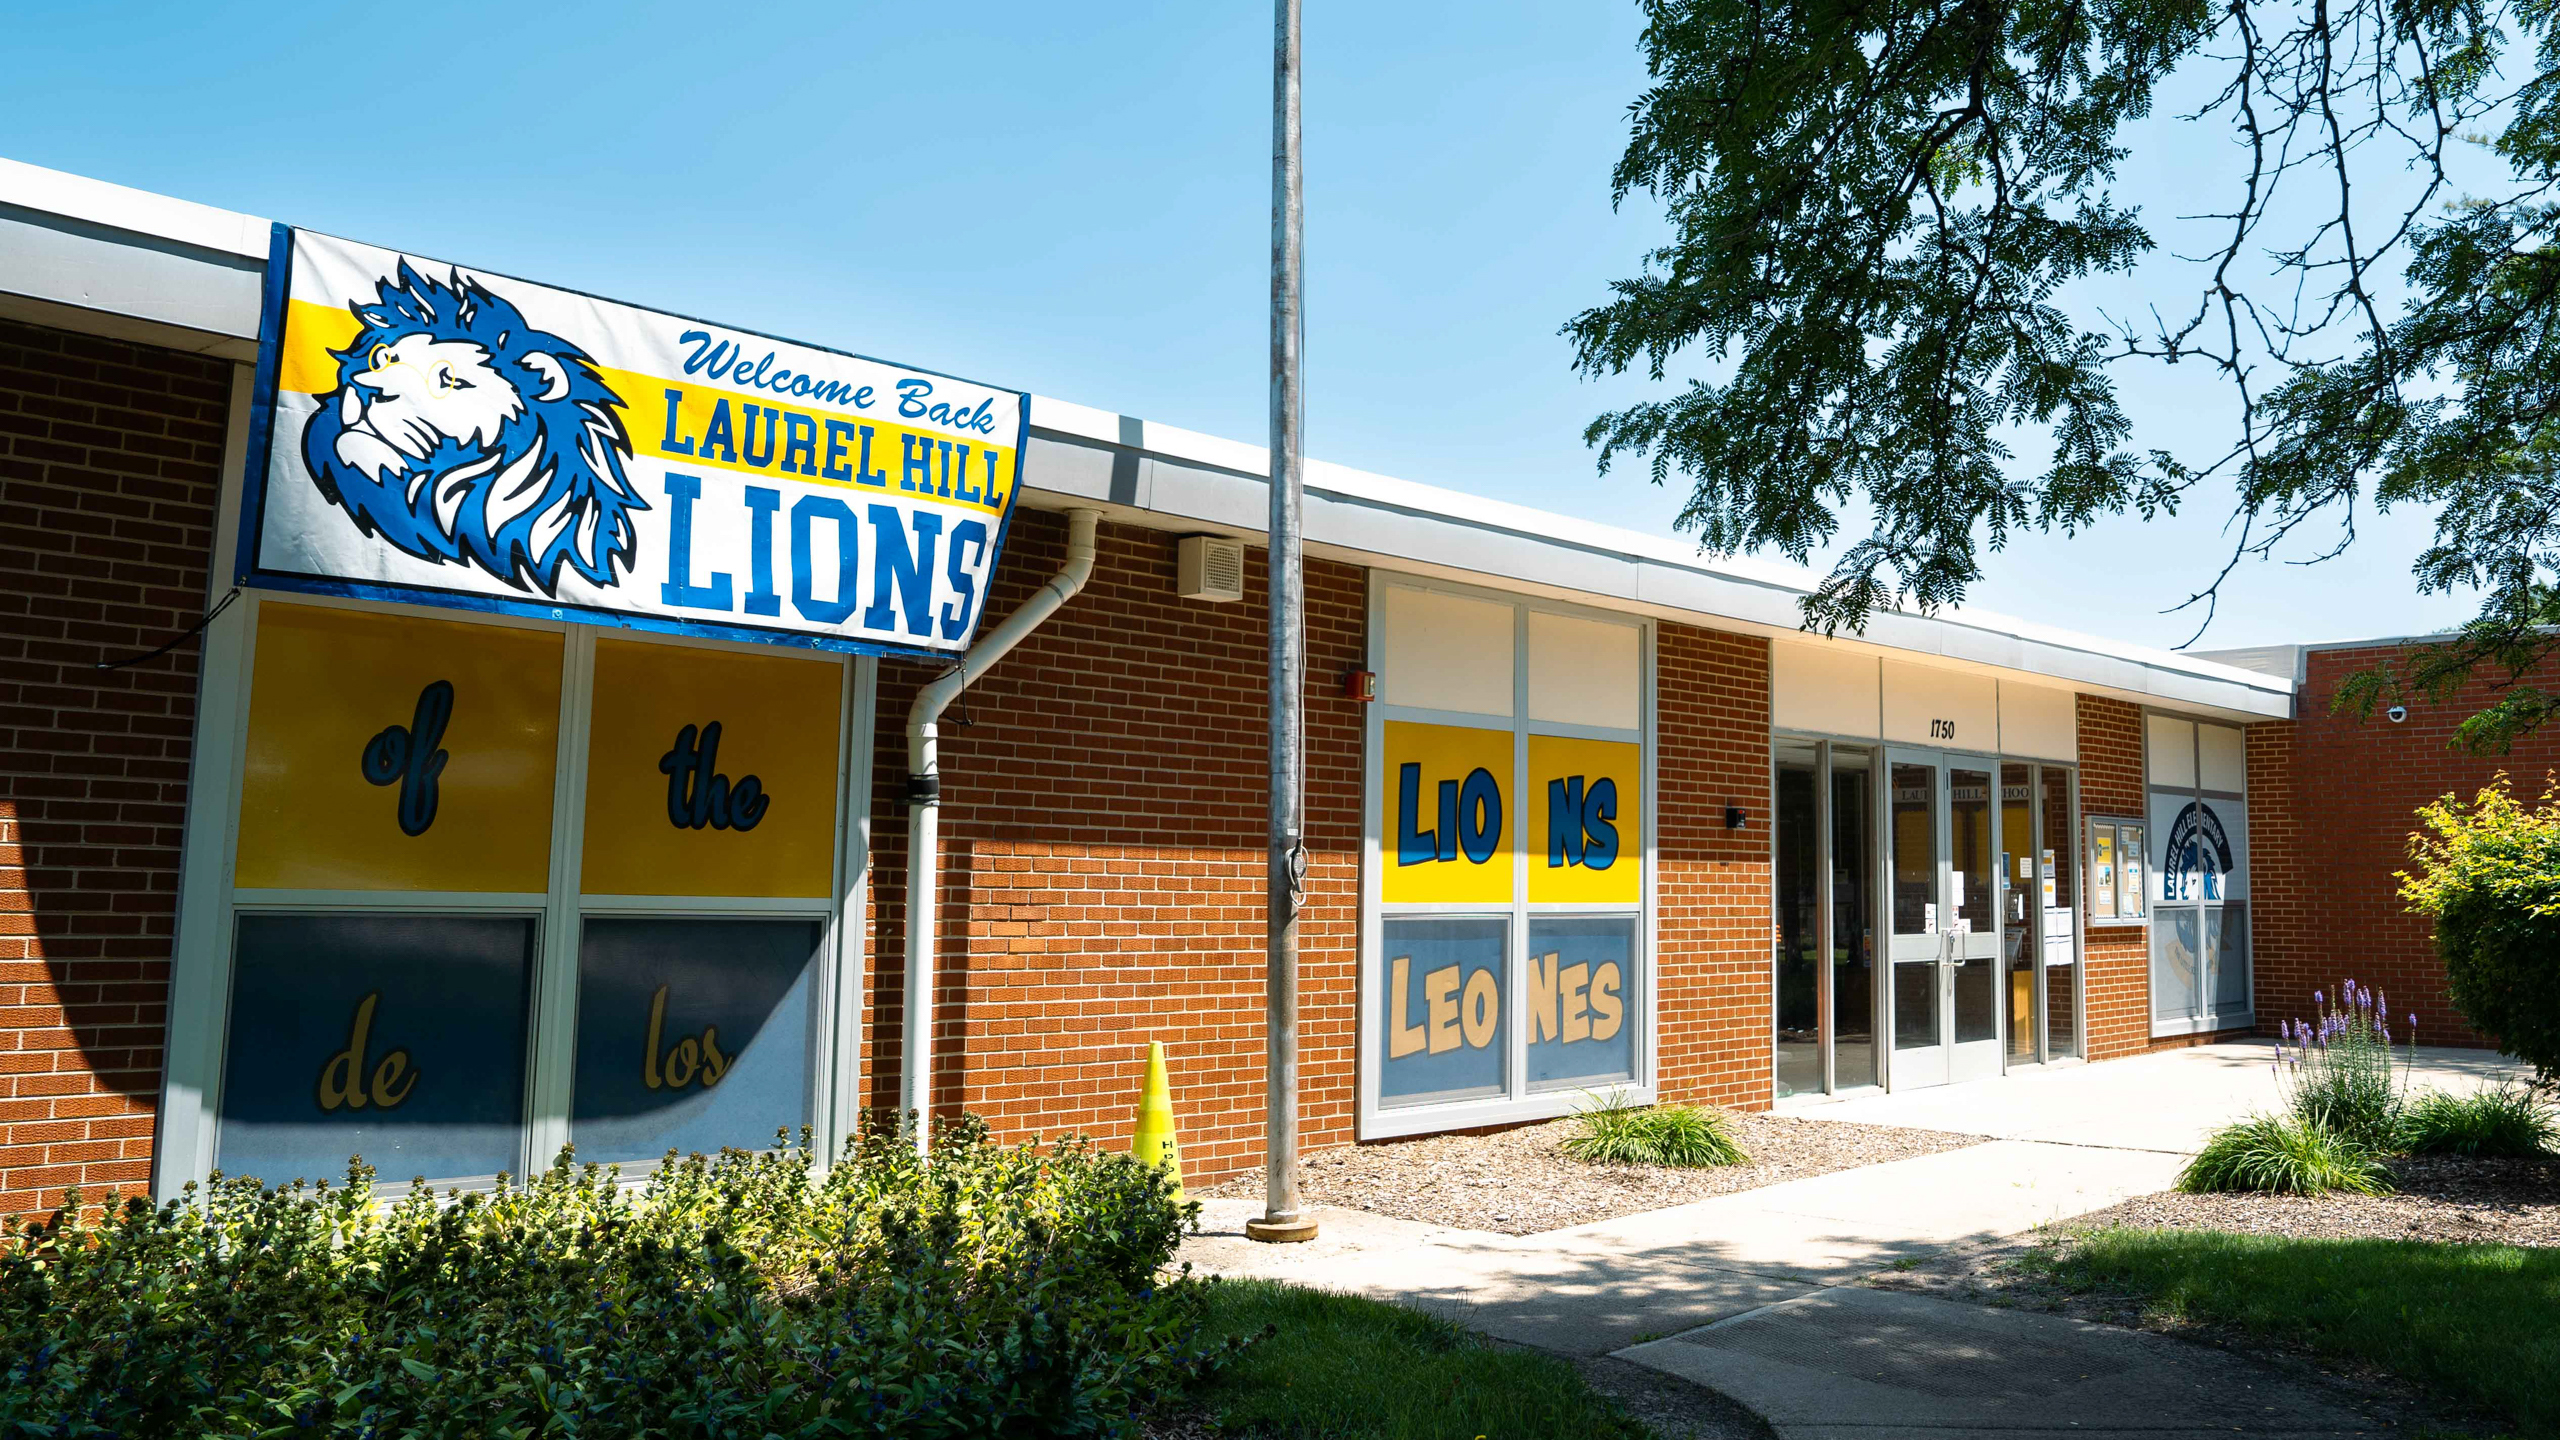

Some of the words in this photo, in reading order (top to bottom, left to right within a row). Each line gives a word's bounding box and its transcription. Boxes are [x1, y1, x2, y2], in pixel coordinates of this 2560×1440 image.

[679, 329, 876, 408] Welcome
[896, 378, 995, 434] Back
[661, 388, 886, 487] LAUREL
[900, 433, 1004, 509] HILL
[661, 471, 987, 641] LIONS
[361, 679, 455, 837] of
[658, 720, 771, 832] the
[1930, 718, 1955, 740] 1750
[2167, 844, 2180, 897] LAUREL
[2174, 819, 2188, 847] HILL
[315, 989, 421, 1114] de
[641, 984, 735, 1094] los
